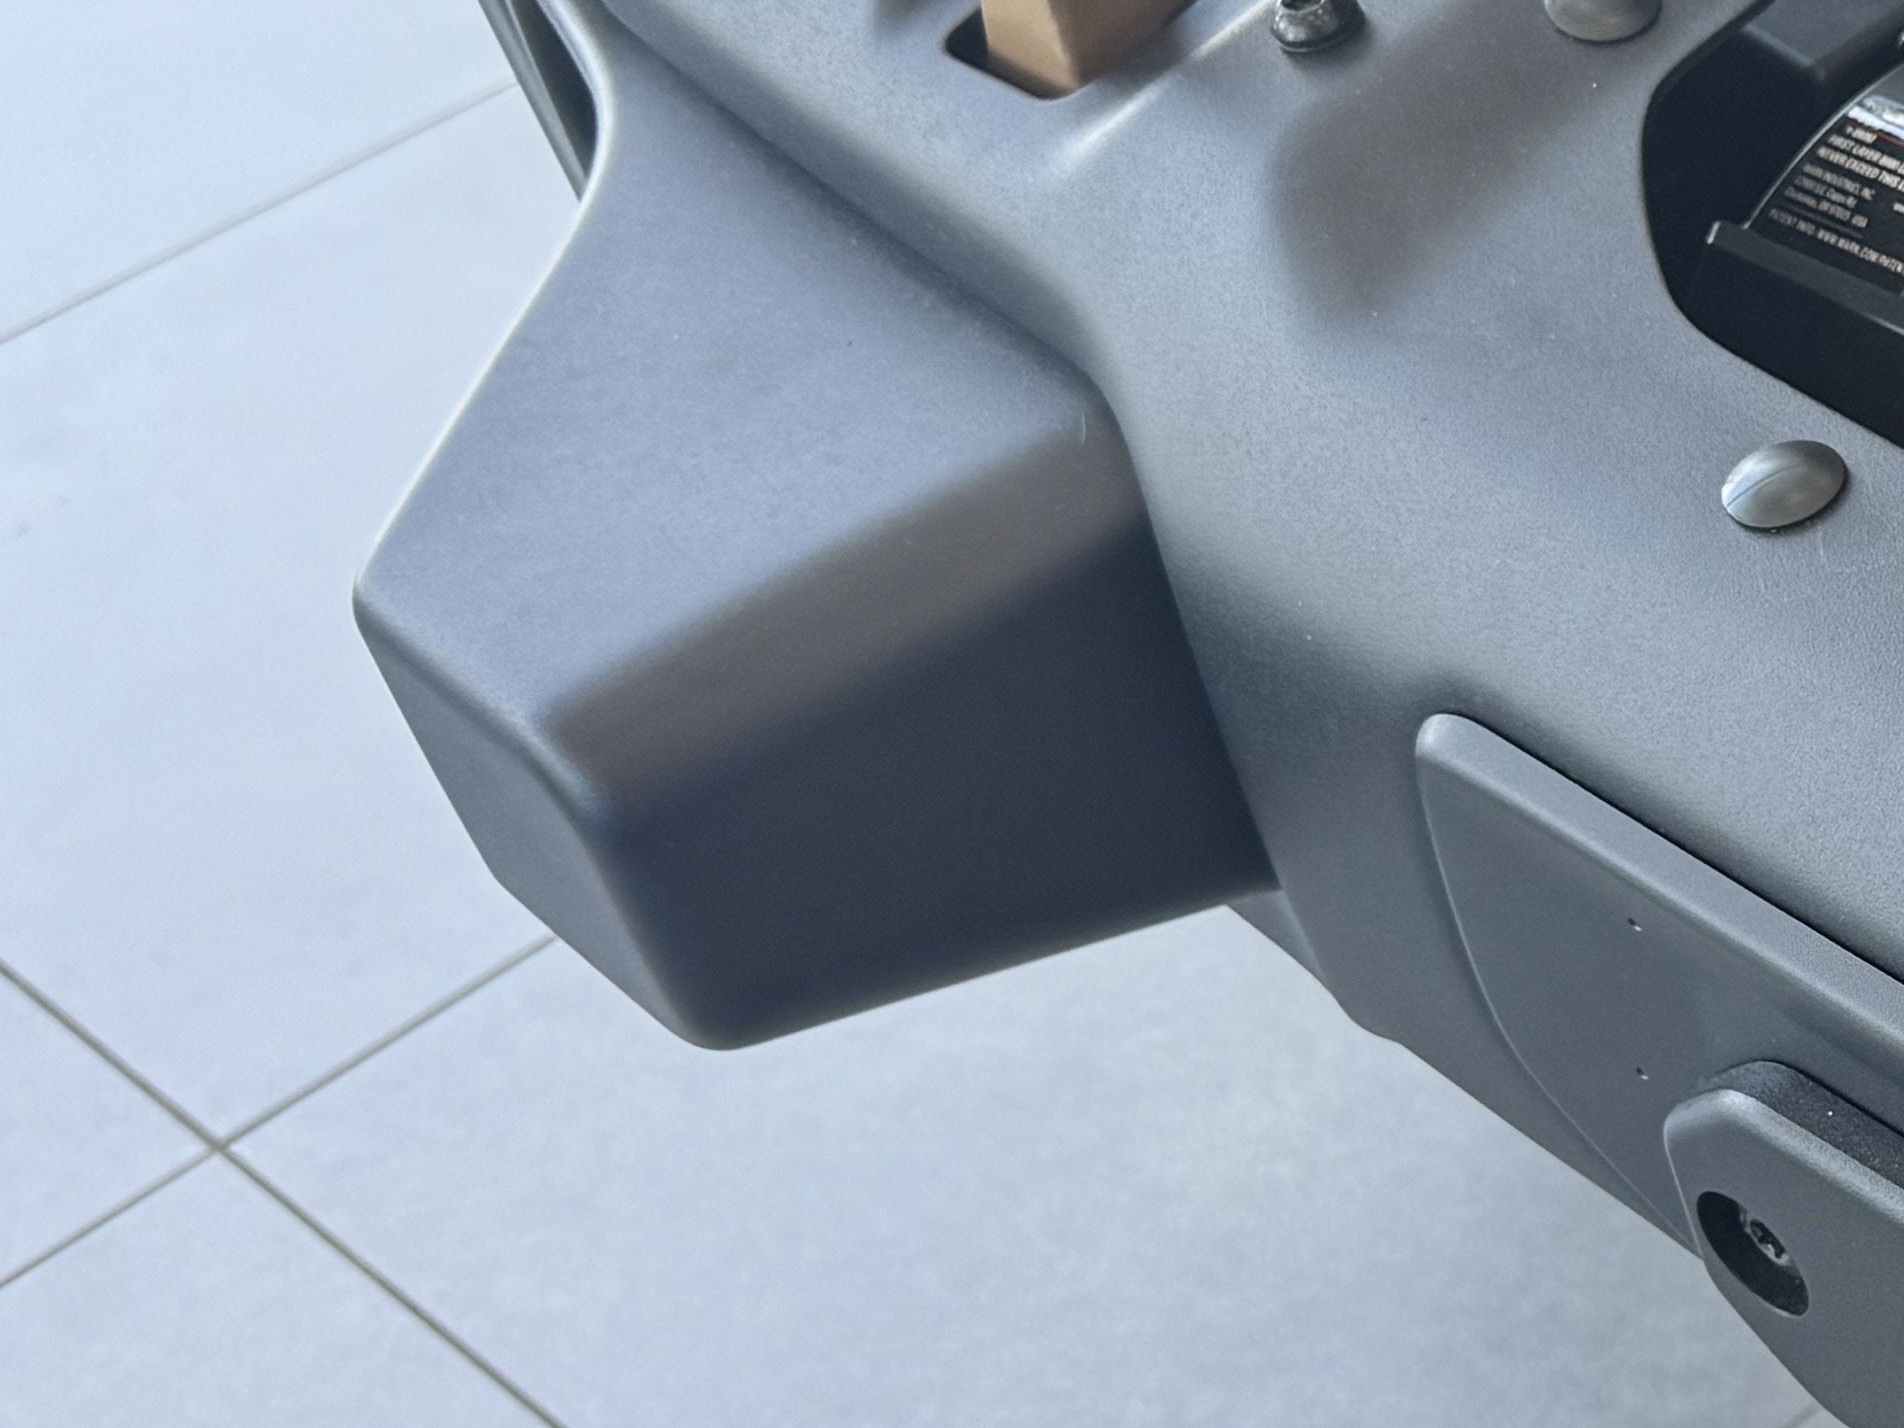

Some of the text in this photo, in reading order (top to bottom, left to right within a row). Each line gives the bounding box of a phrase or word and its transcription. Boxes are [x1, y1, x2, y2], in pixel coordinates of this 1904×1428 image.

[1816, 145, 1850, 167] NEVER
[1845, 157, 1881, 180] EXCEED
[1878, 170, 1902, 188] THIS
